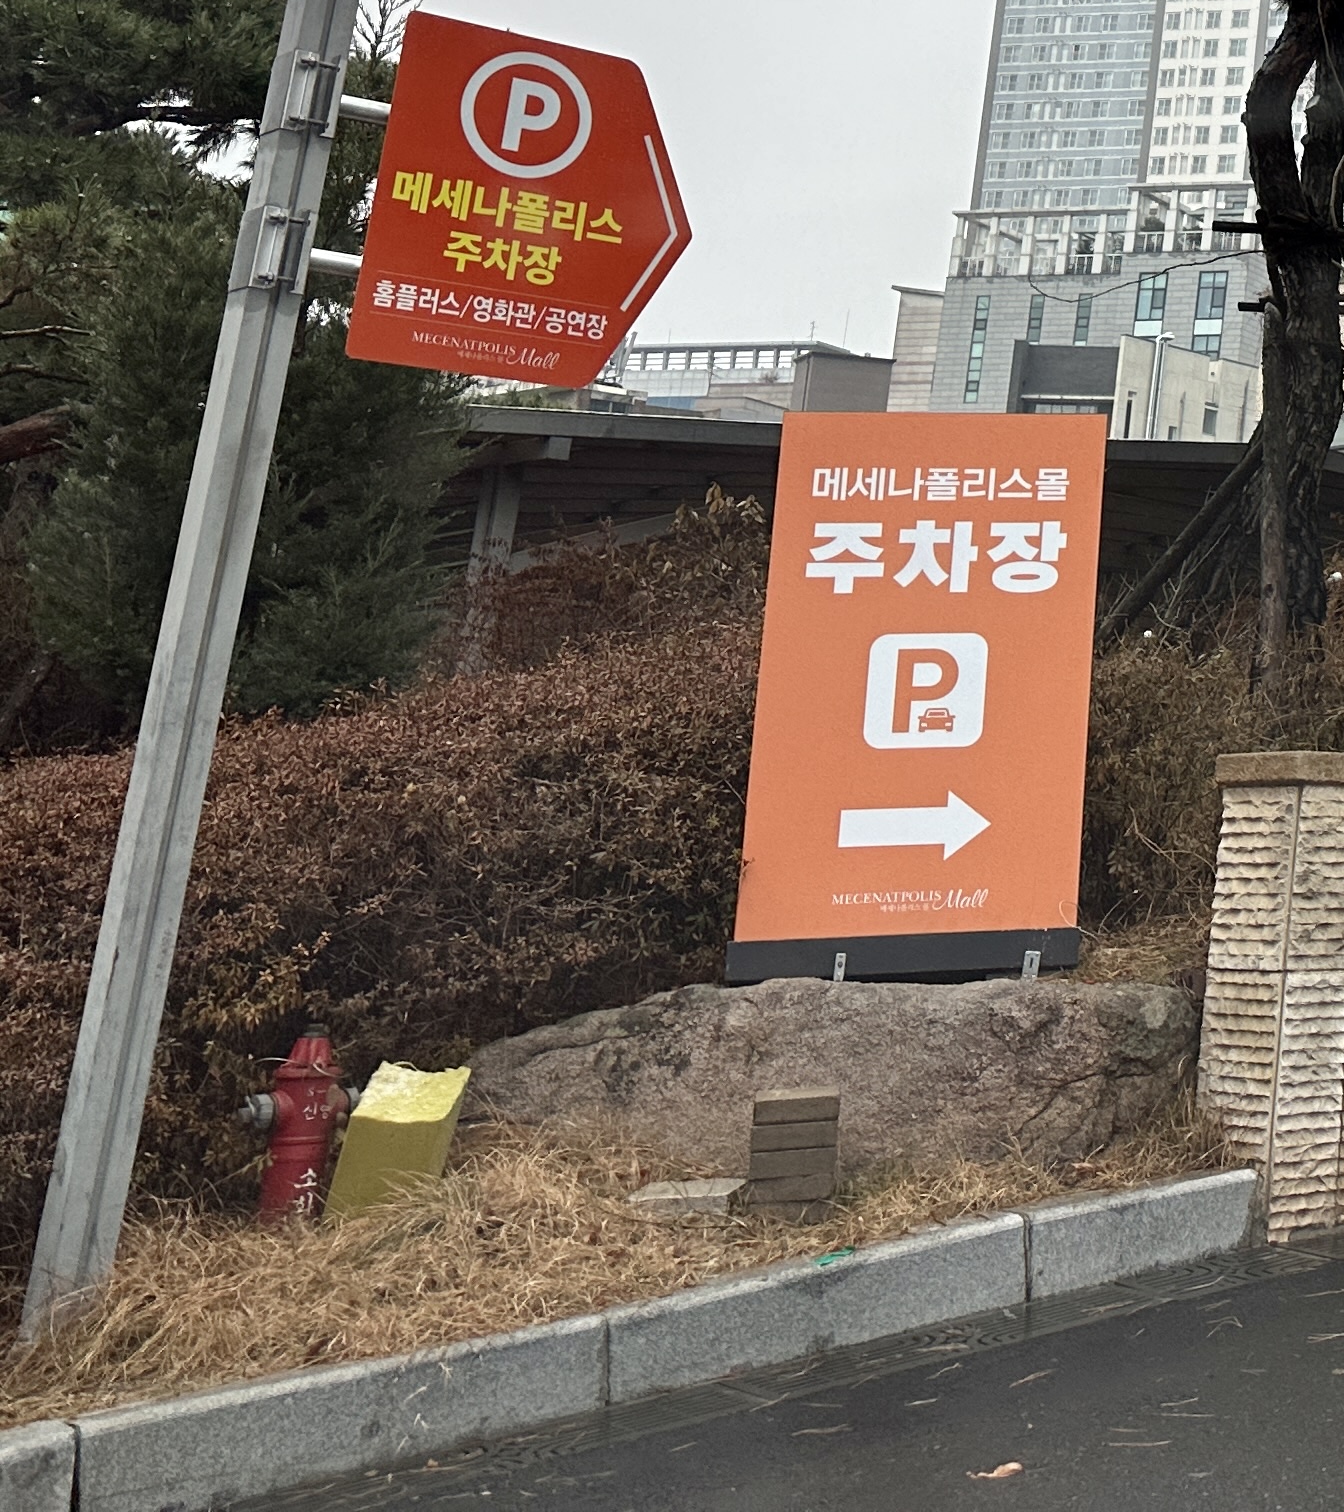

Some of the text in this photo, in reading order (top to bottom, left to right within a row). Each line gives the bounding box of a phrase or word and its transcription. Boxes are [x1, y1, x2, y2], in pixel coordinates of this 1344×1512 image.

[501, 78, 561, 151] P
[392, 170, 623, 245] 메세나폴리스
[443, 231, 562, 286] 주차장
[412, 331, 560, 370] MECENATPOLIS Mall
[812, 467, 1070, 502] 메세나폴리스몰
[805, 520, 1067, 594] 주차장
[831, 888, 989, 911] MECENATPOLIS Mall
